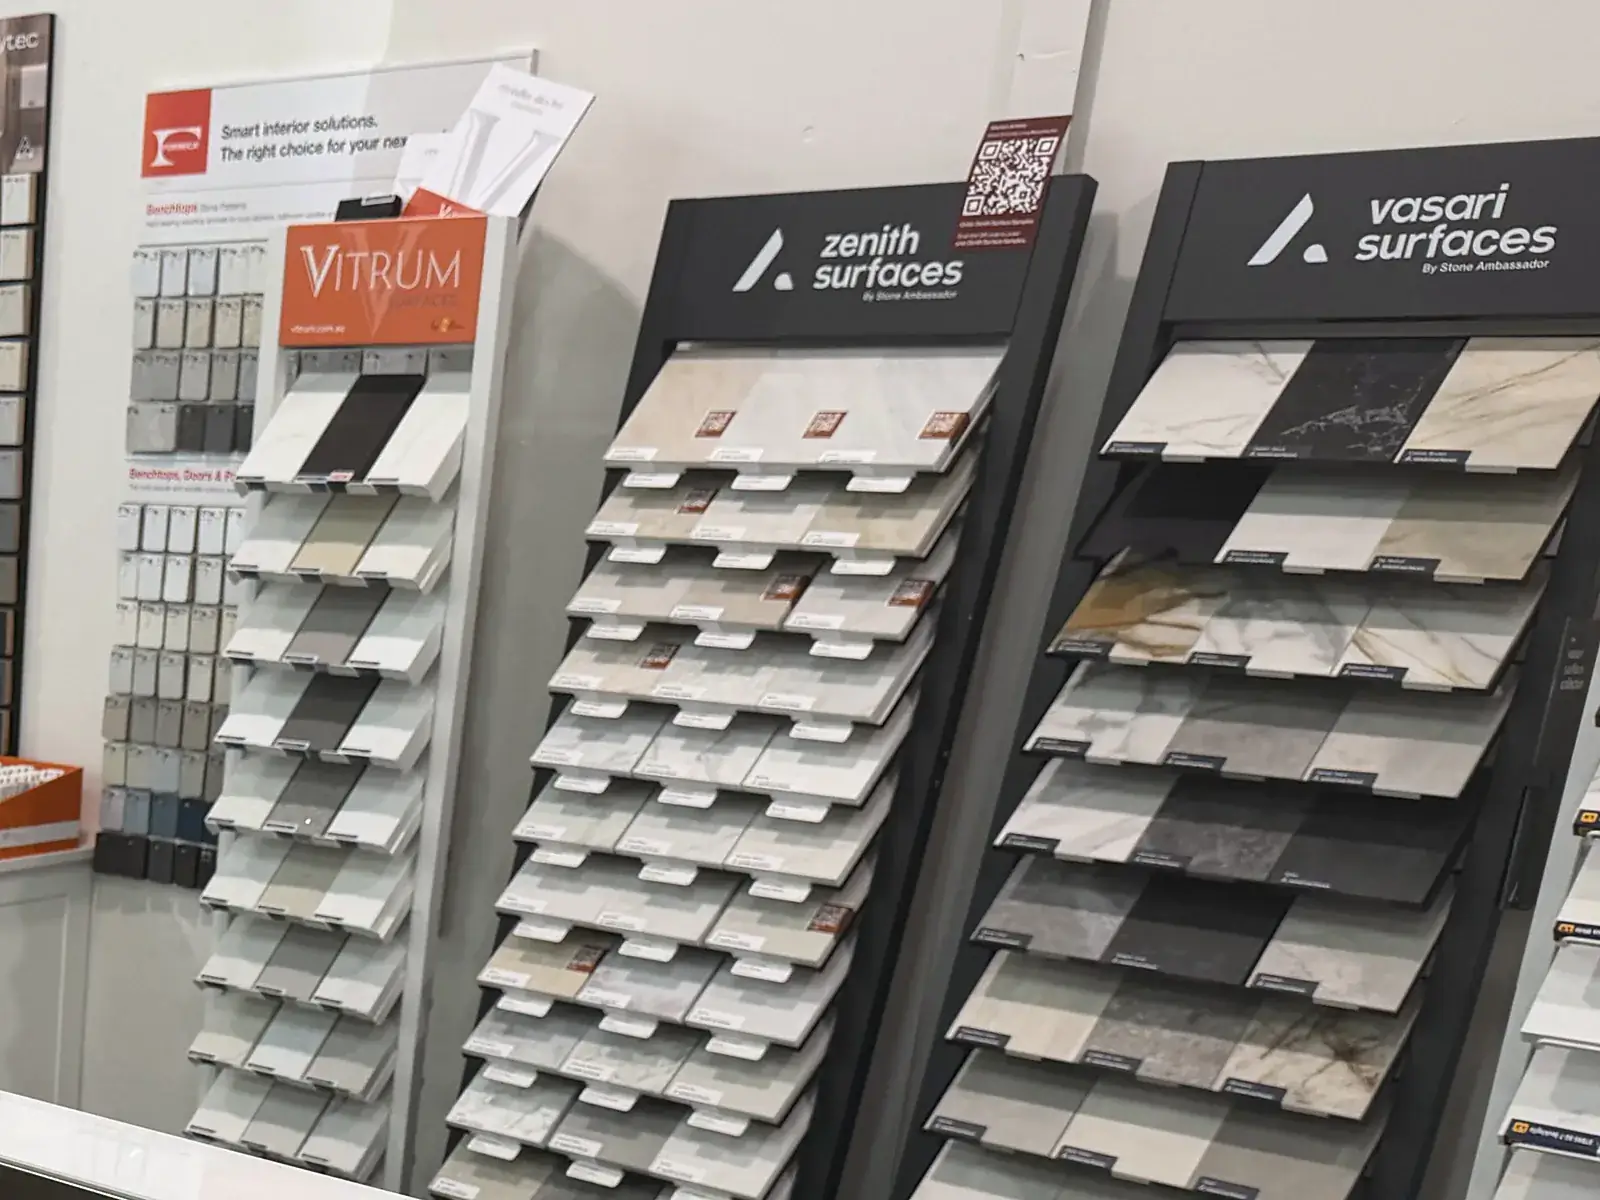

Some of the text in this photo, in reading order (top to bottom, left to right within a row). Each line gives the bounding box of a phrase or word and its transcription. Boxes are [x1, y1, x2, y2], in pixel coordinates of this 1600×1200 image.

[221, 113, 378, 140] Smart interior solutions.
[221, 146, 243, 162] The
[247, 144, 276, 163] right
[280, 140, 324, 157] choice
[327, 138, 346, 154] for
[349, 138, 380, 155] your
[1370, 183, 1510, 225] vasari
[820, 223, 920, 258] zenith
[1354, 223, 1558, 261] surfaces
[300, 243, 461, 298] VITRUM
[812, 257, 965, 290] surfaces
[1422, 259, 1550, 275] By Stone Ambassador
